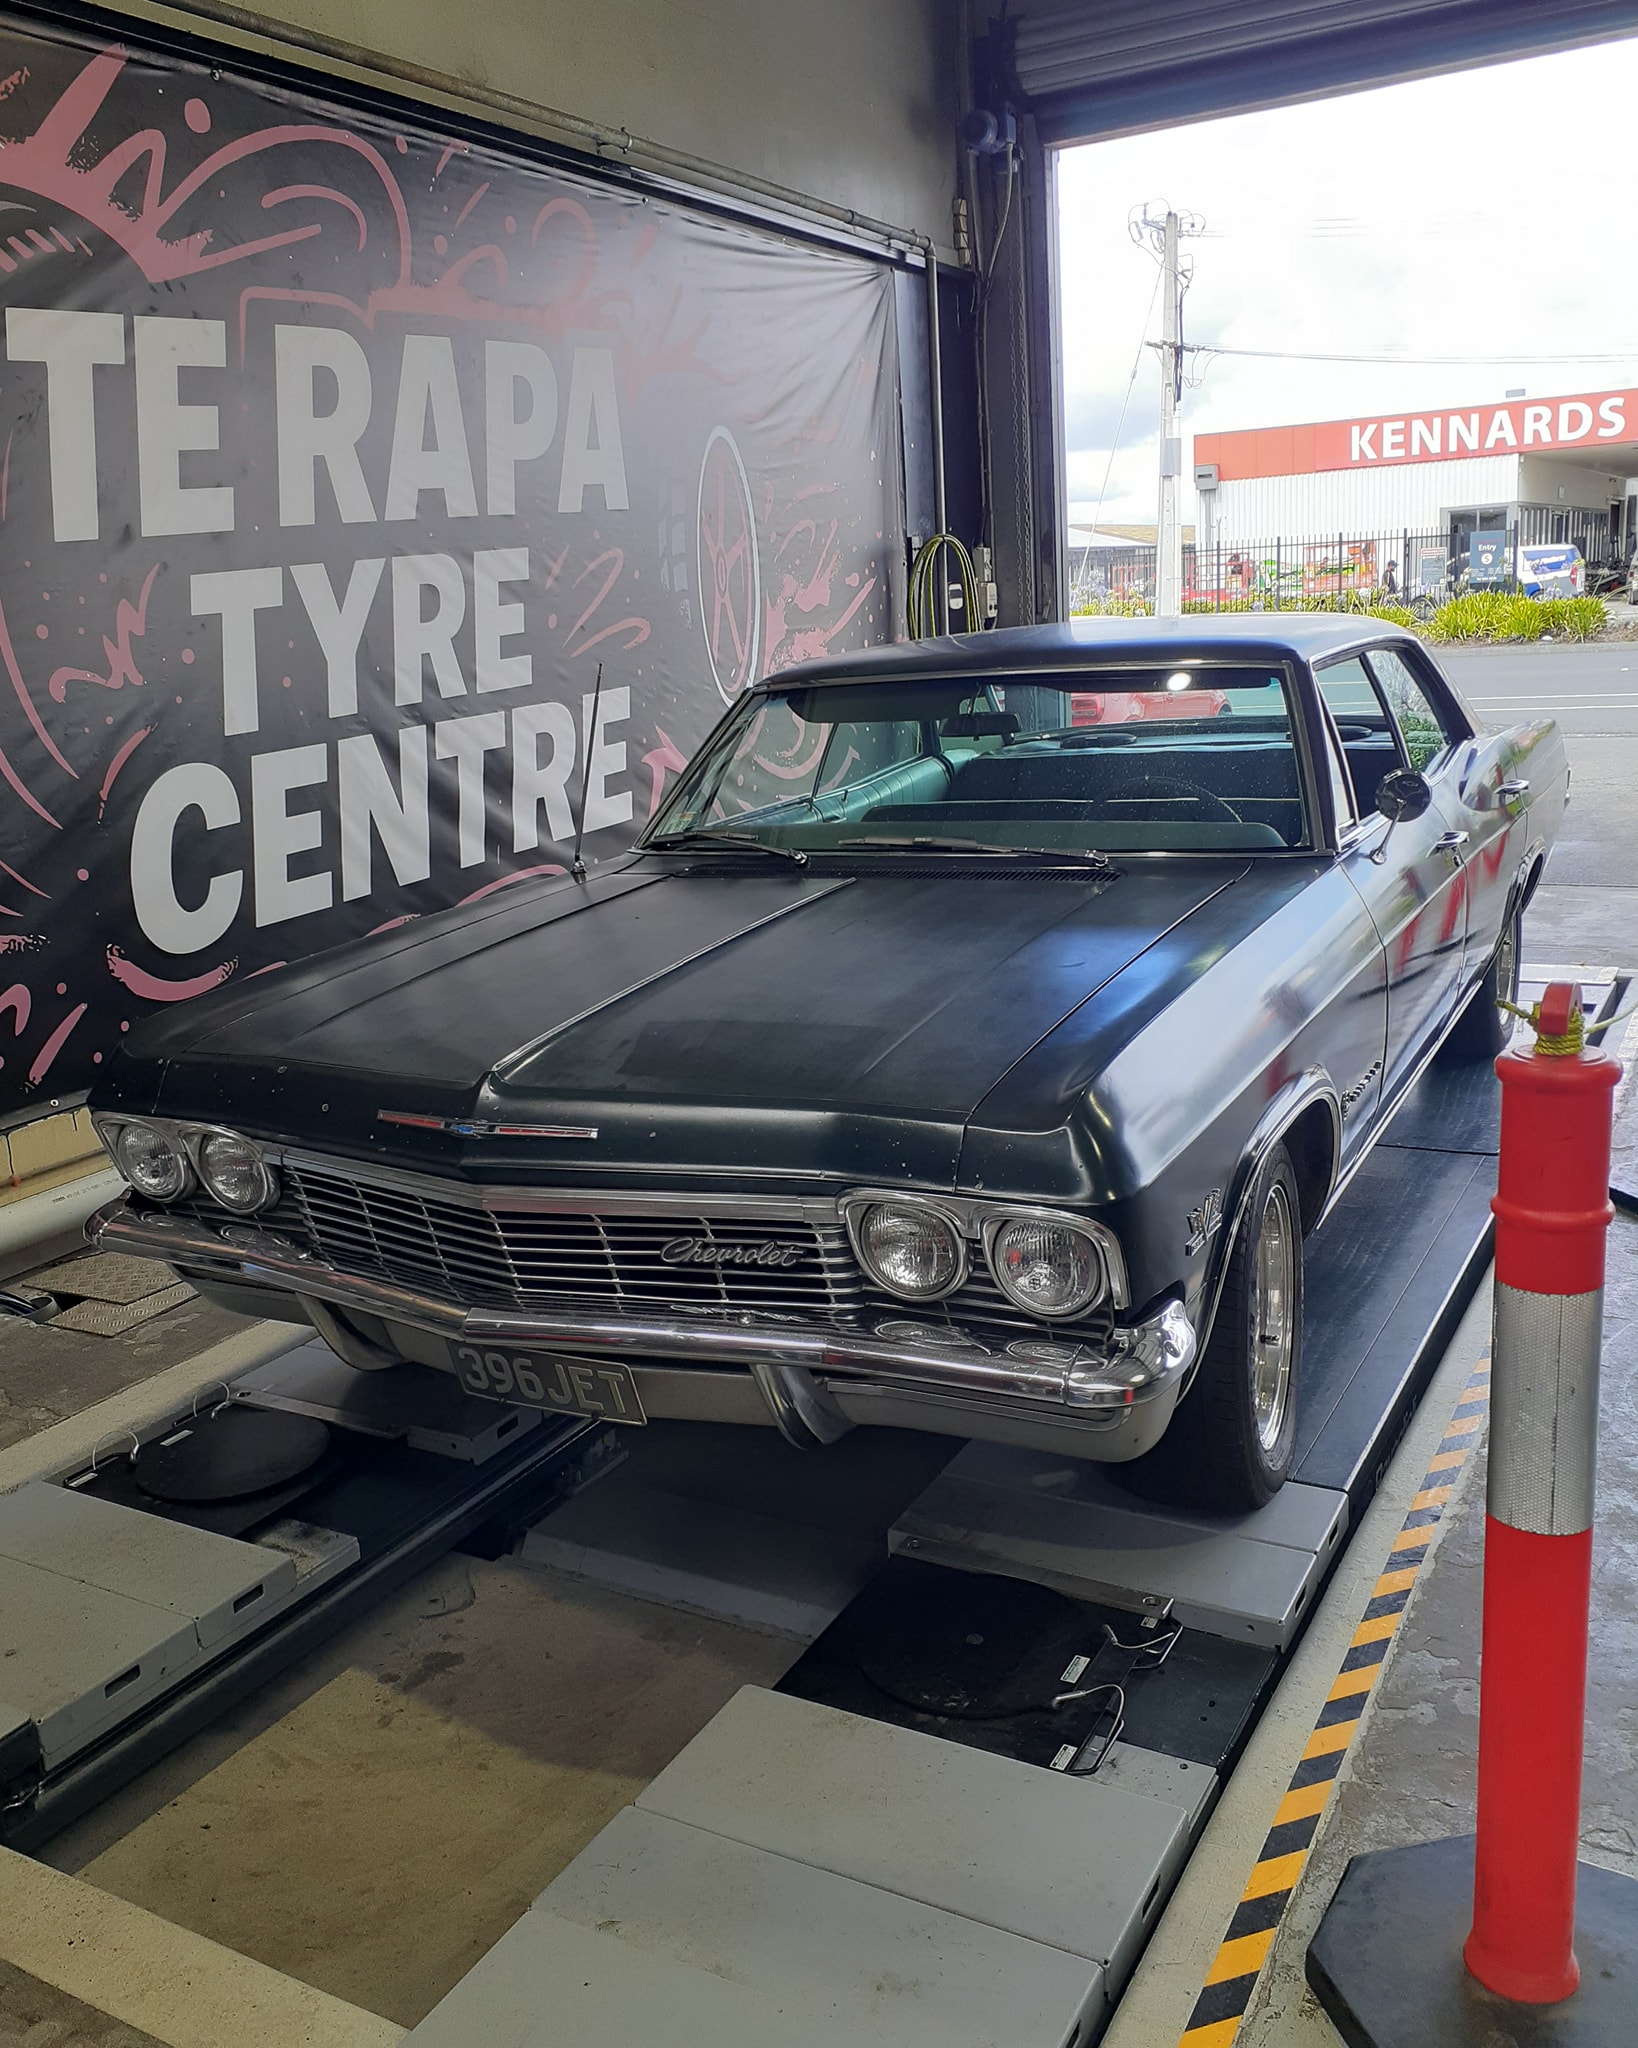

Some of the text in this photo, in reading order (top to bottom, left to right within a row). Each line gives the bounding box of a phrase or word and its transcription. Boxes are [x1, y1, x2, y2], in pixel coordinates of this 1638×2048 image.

[5, 307, 630, 542] TE RAPA
[1351, 397, 1625, 461] KENNARDS
[1478, 544, 1496, 552] Entry
[190, 547, 533, 737] TYRE
[129, 686, 634, 955] CENTRE
[660, 1236, 804, 1268] Chevrolet
[458, 1347, 627, 1414] 396JET
